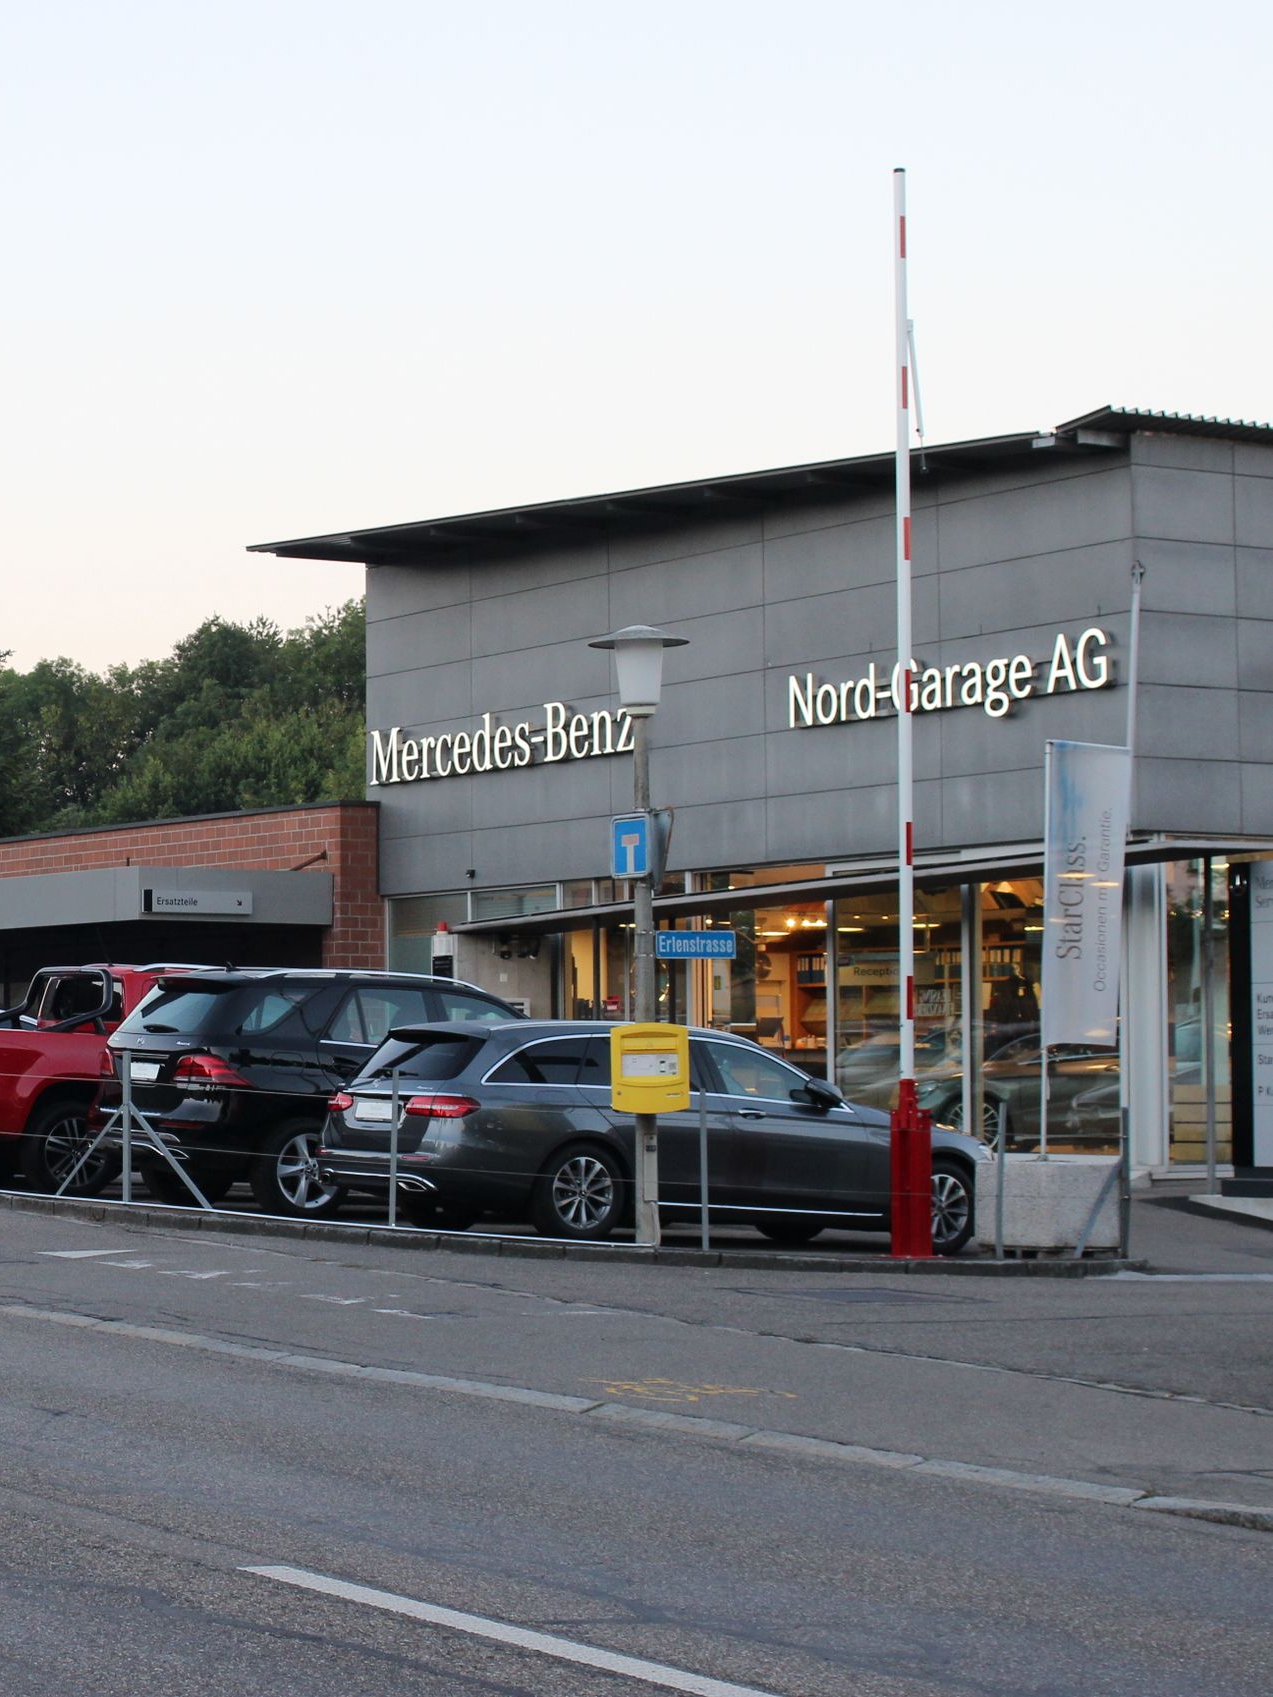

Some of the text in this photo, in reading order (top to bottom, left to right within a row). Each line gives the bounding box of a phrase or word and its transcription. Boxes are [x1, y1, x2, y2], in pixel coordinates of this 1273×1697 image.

[788, 627, 1109, 728] Nord-Garage AG
[370, 701, 635, 785] Mercedes-Benz
[156, 896, 198, 906] Ersatzteile
[1055, 836, 1087, 960] StarClass.
[658, 935, 733, 953] Erlenstrasse
